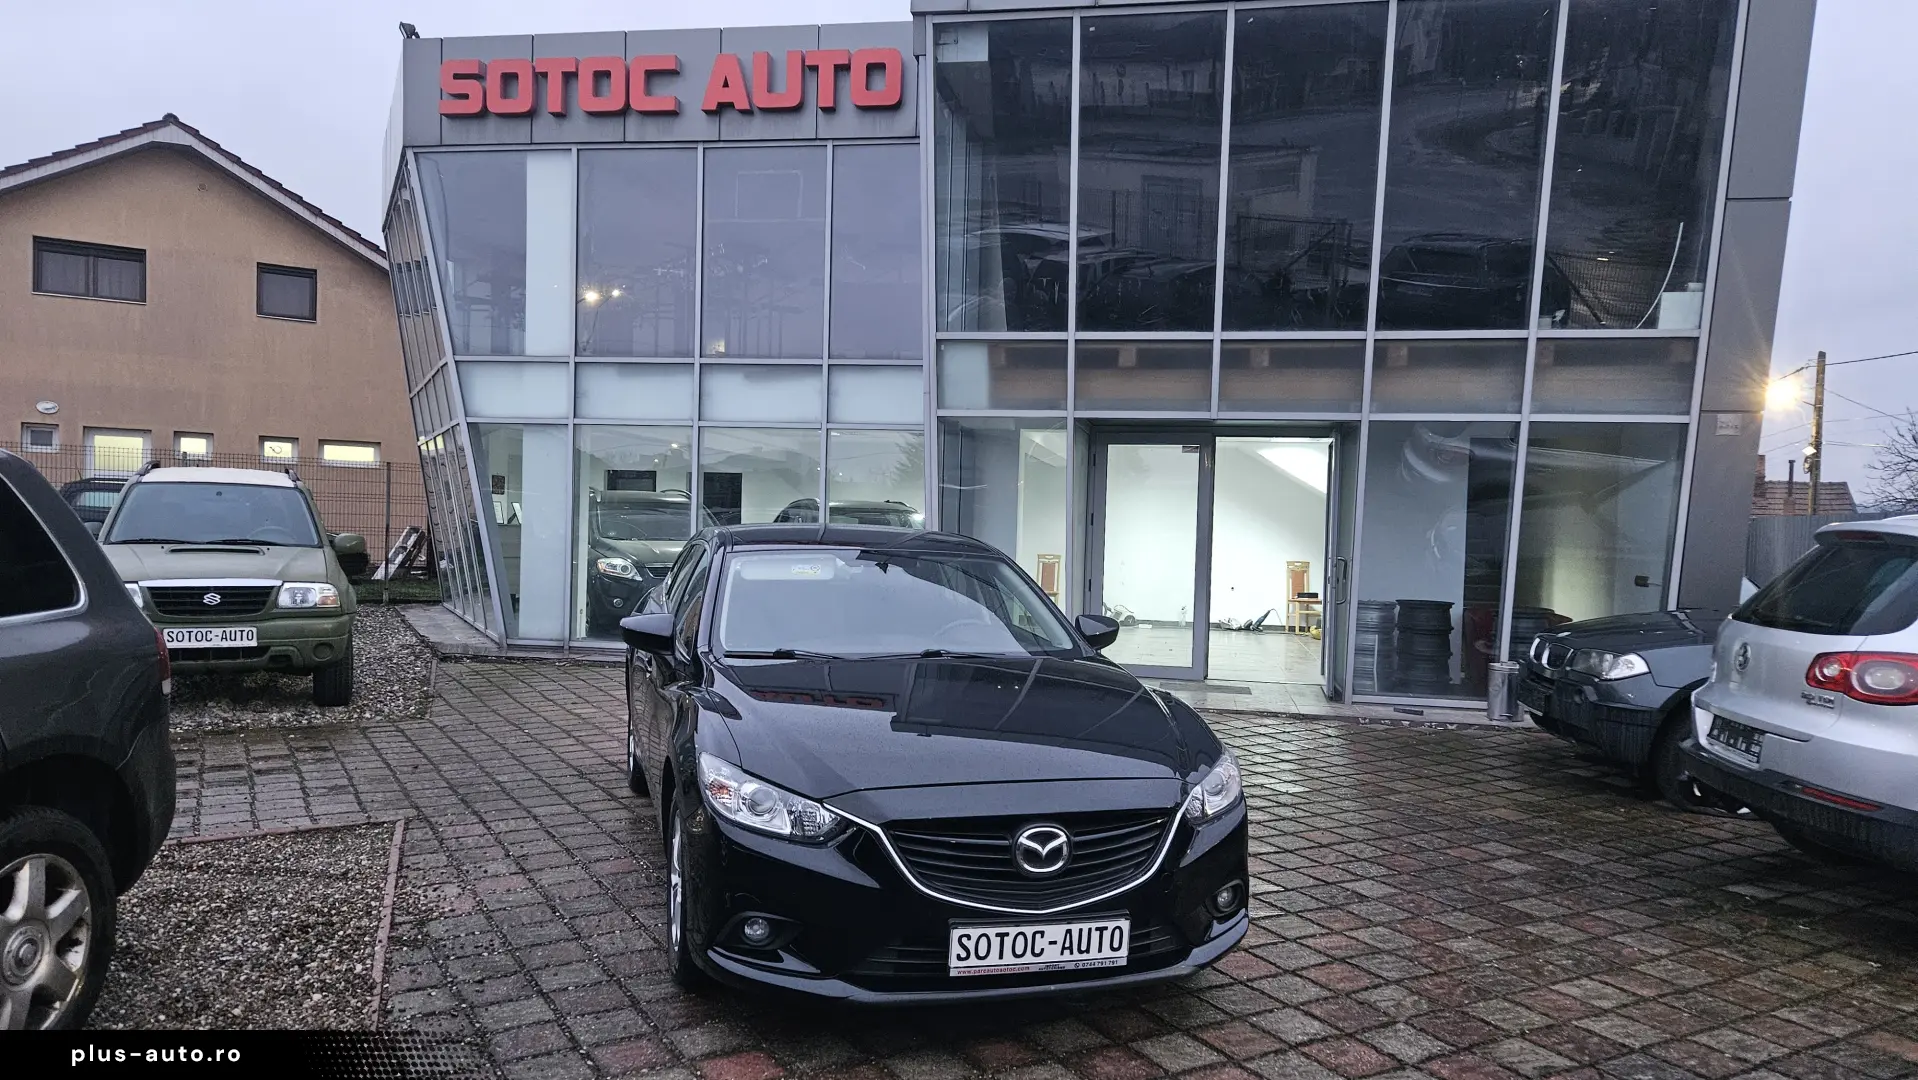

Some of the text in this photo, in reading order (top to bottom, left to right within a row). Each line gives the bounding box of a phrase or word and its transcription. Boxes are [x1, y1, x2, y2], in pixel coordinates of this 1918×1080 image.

[438, 47, 905, 117] SOTOC AUTO
[166, 630, 254, 643] SOTOC-AUTO
[956, 925, 1124, 961] SOTOC-AUTO
[957, 965, 1030, 975] www.parcautosotoc.com
